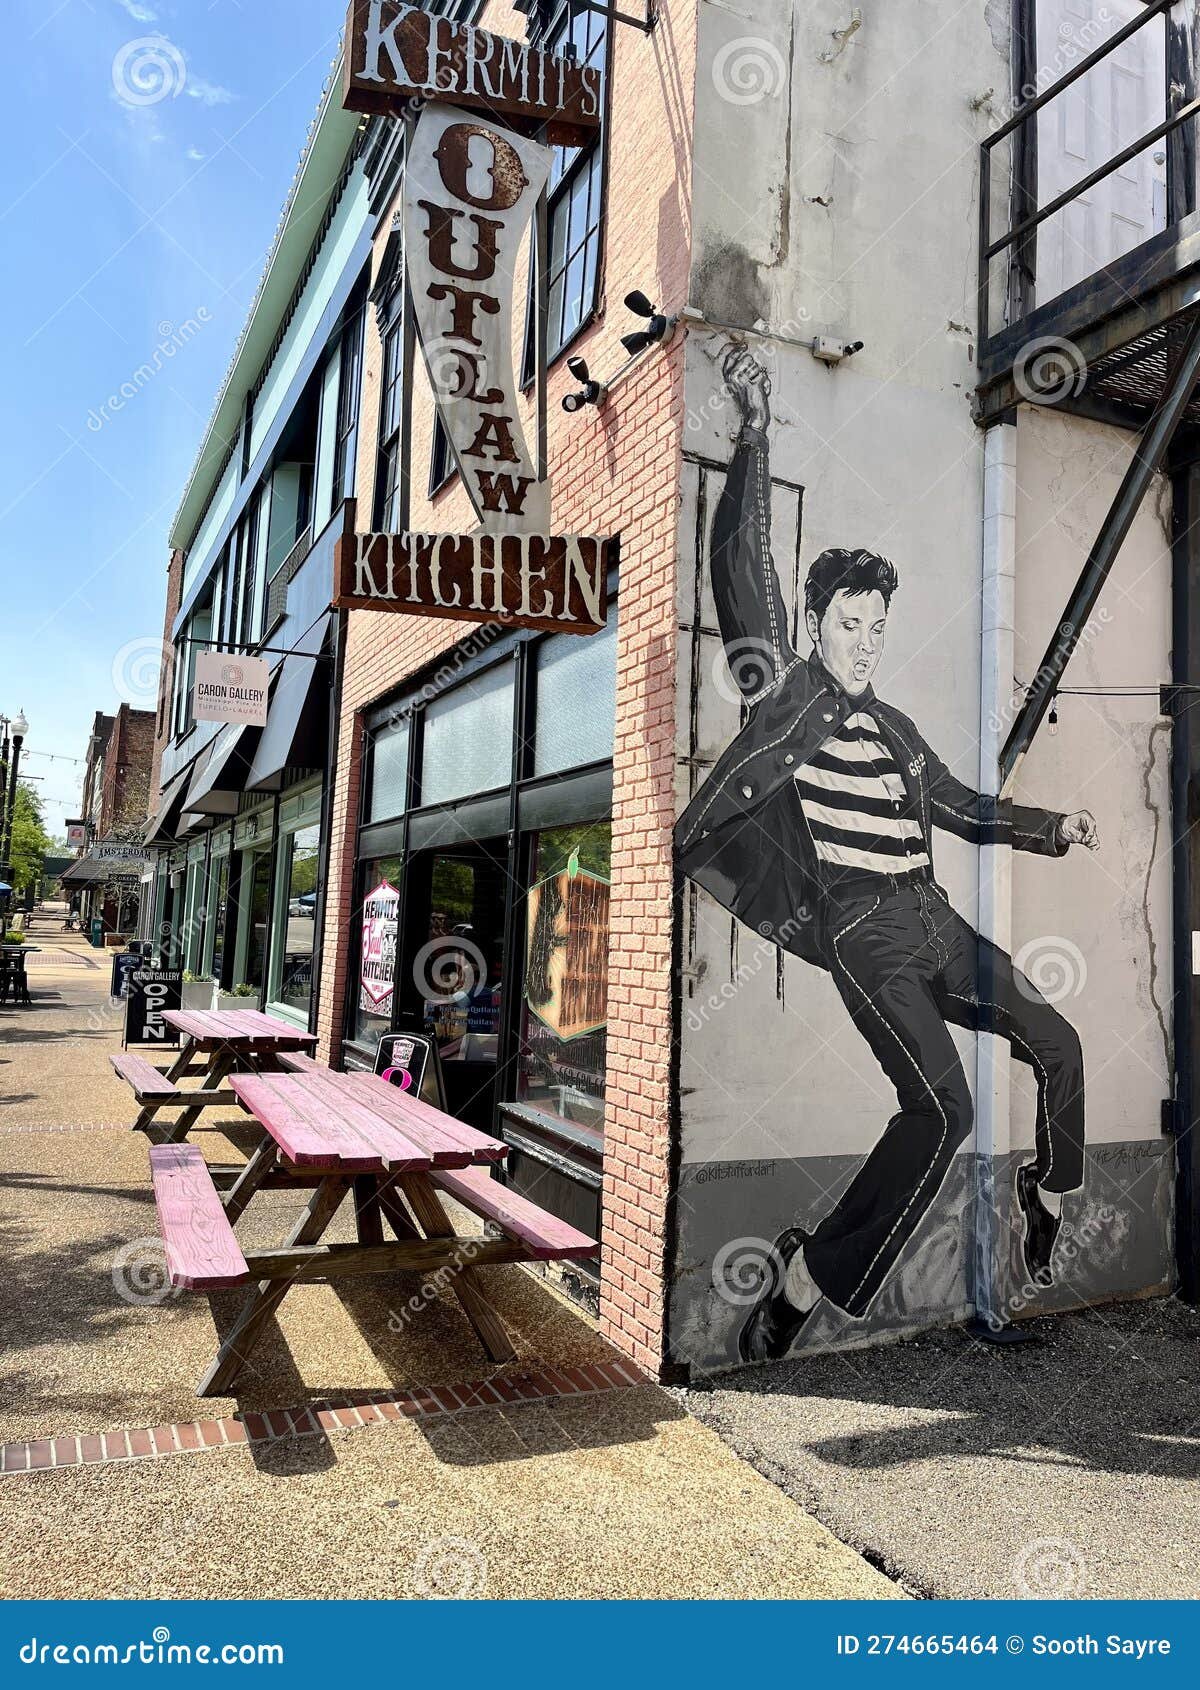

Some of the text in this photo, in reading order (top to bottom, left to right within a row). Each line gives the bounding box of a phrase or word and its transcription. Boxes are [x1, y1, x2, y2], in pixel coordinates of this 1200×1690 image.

[354, 0, 601, 116] KERMIT'S
[417, 123, 536, 515] OUTLAW
[352, 531, 608, 627] KITCHEN
[198, 683, 264, 702] CARON GALLERY
[98, 847, 151, 861] AMSTERDAM
[155, 972, 180, 981] GALLERY
[143, 984, 168, 1039] OPEN
